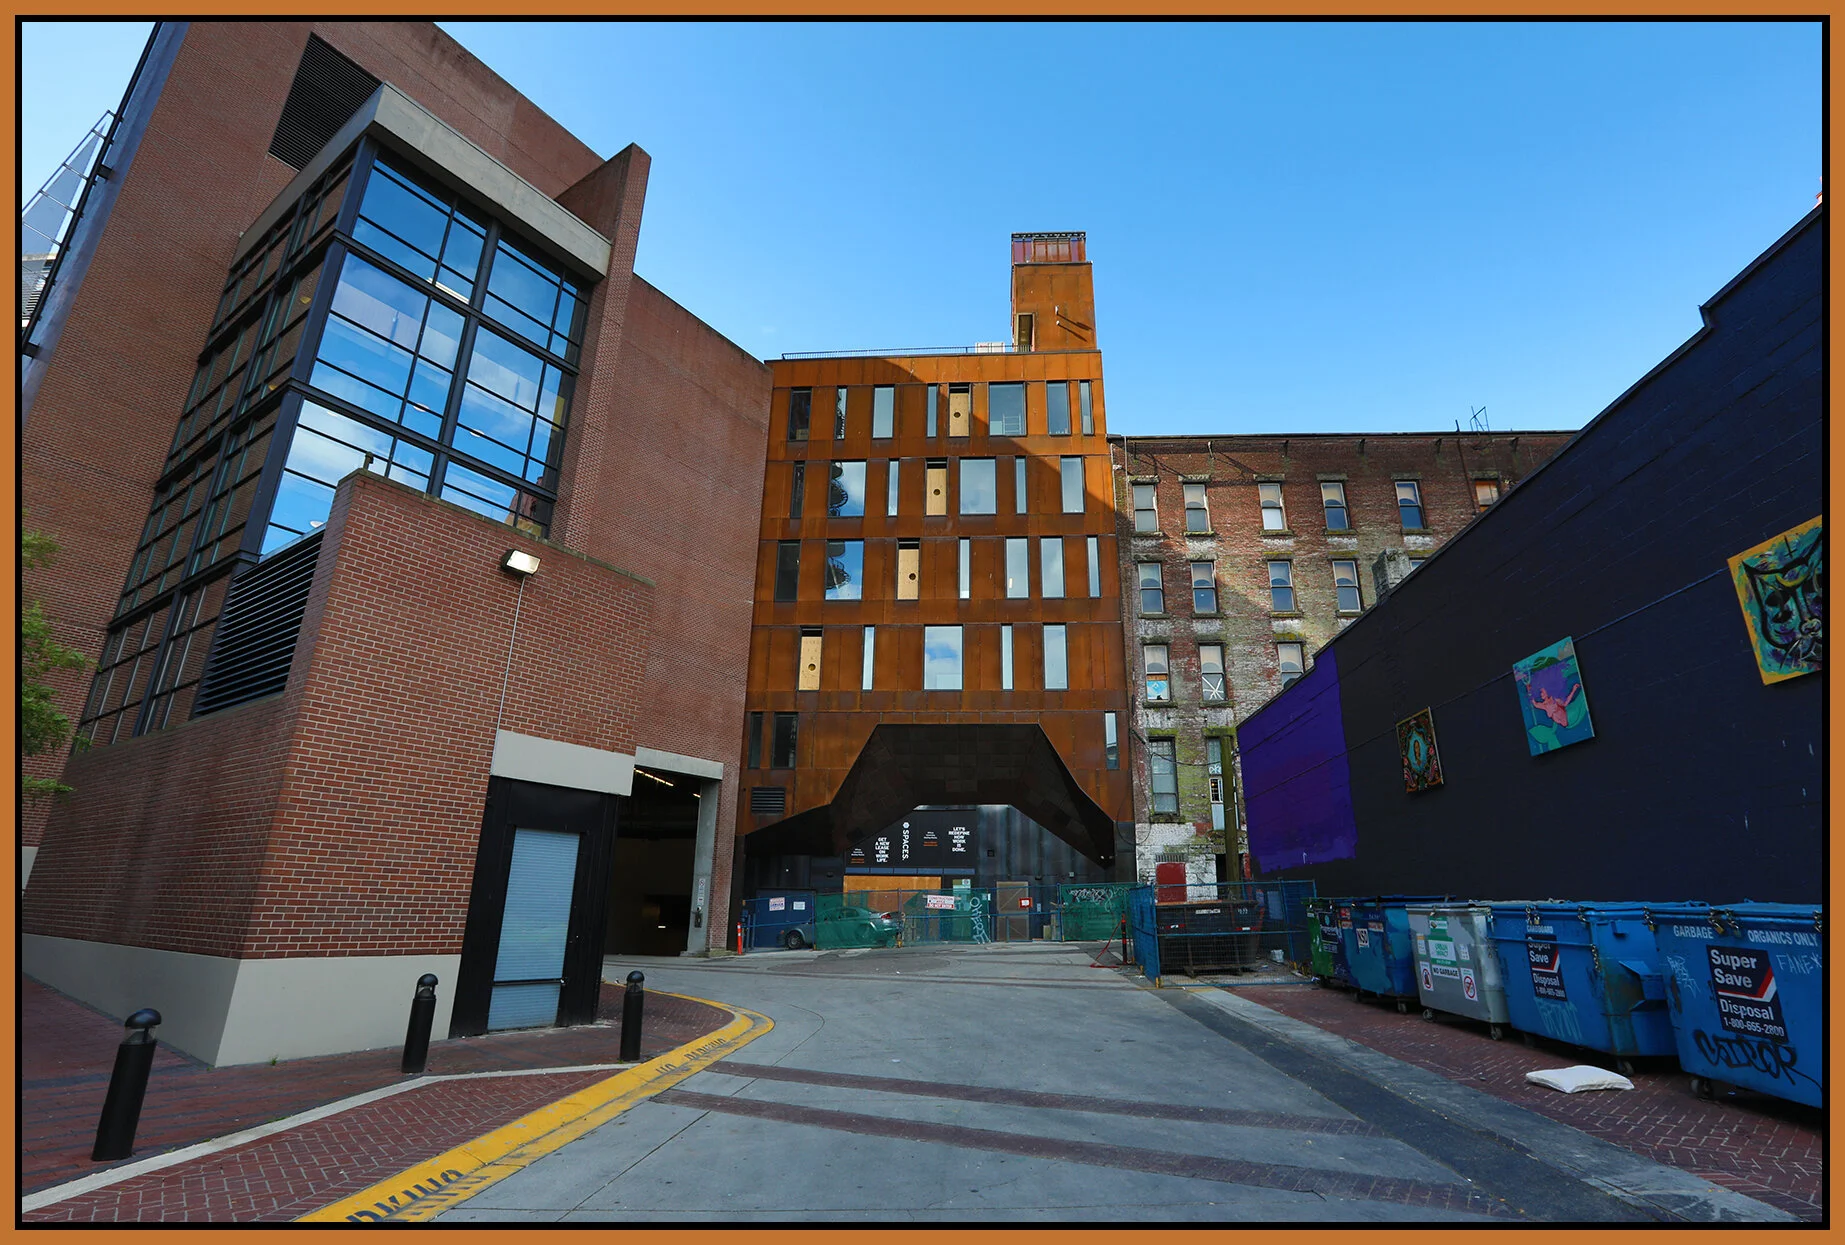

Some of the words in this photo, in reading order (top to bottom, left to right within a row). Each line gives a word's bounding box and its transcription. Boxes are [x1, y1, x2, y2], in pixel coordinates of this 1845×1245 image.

[902, 829, 910, 861] SPACES.
[1673, 925, 1714, 939] GARBAGE
[1747, 930, 1793, 944] ORGANICS
[1794, 935, 1818, 947] ONLY
[1530, 951, 1549, 963] Save
[1710, 949, 1757, 970] Super
[1439, 968, 1458, 977] GARBAGE
[1533, 973, 1560, 986] Disposal
[1714, 968, 1752, 988] Save
[1720, 998, 1774, 1020] Disposal
